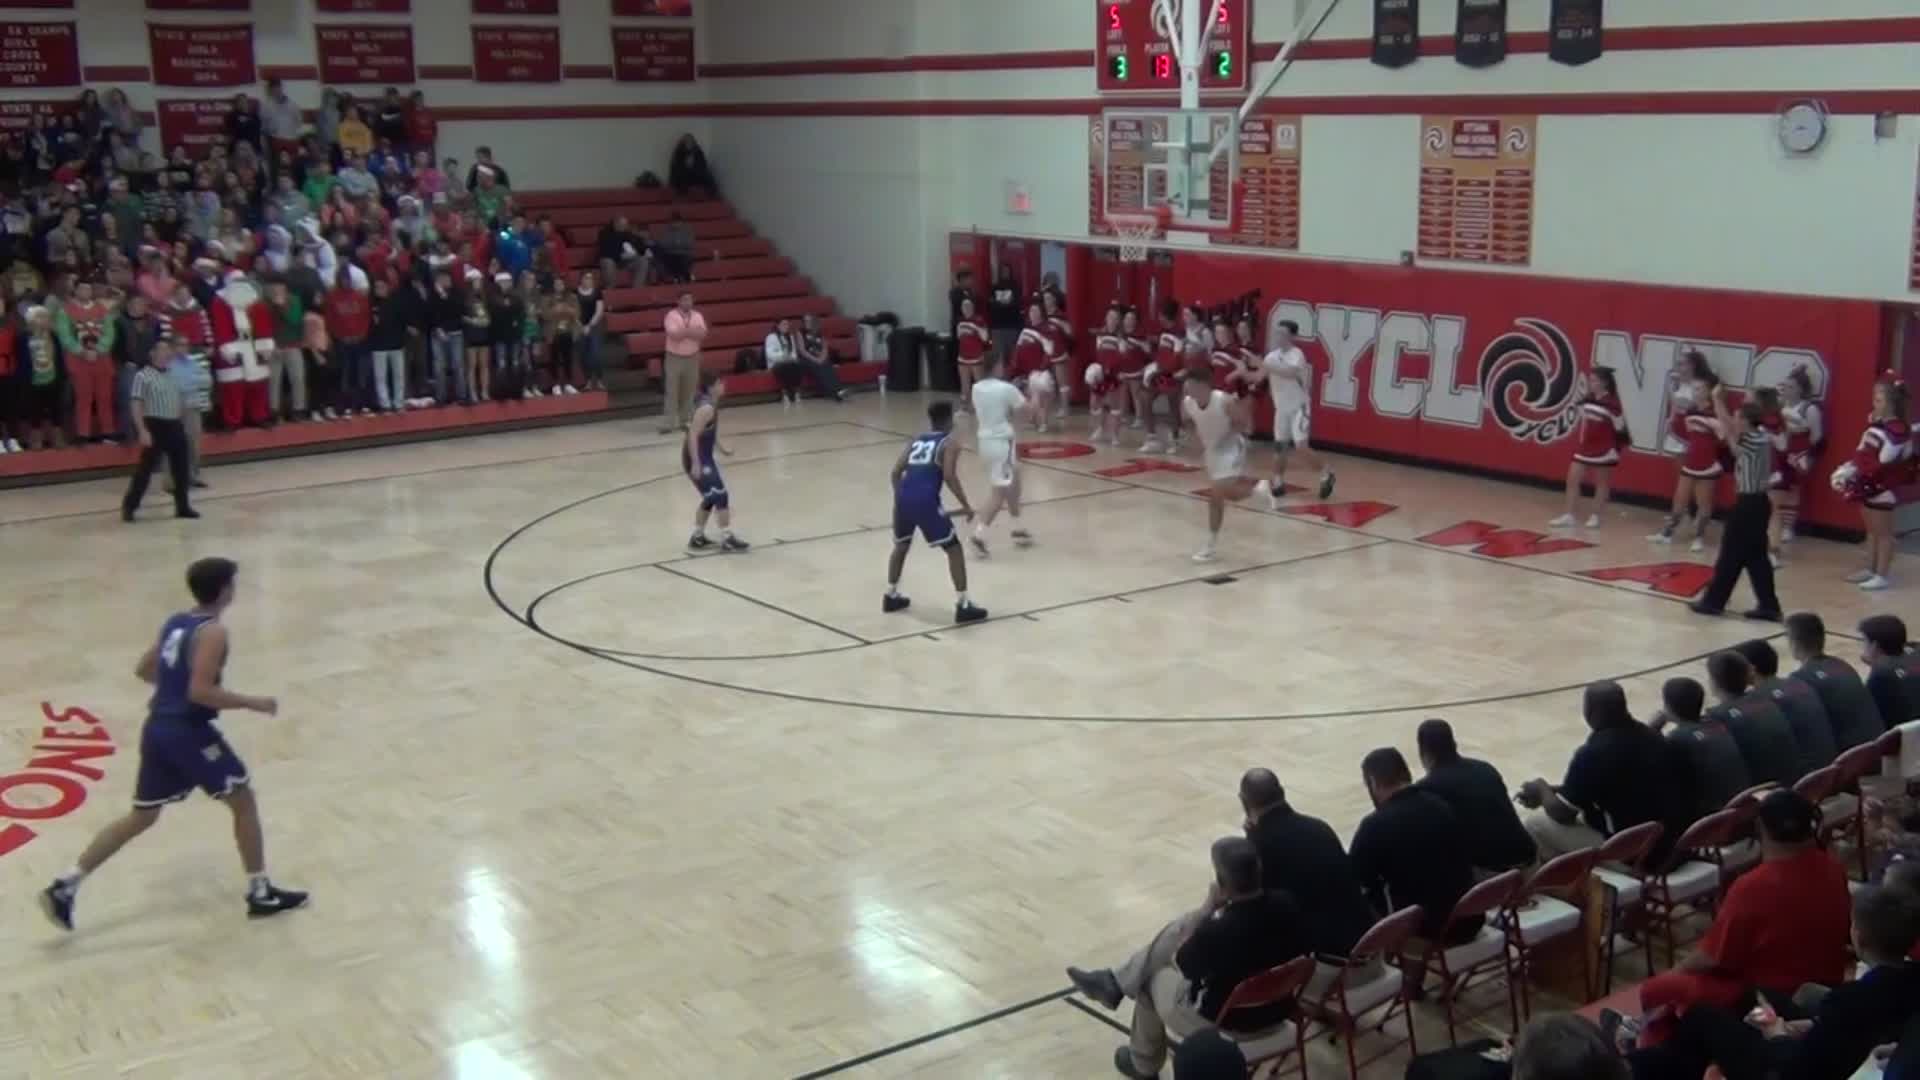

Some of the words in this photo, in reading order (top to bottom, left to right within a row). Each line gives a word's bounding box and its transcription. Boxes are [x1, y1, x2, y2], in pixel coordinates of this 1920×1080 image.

[1110, 5, 1120, 28] 5
[1116, 56, 1126, 78] 3
[1155, 55, 1170, 78] 13
[1219, 52, 1230, 75] 2
[908, 440, 935, 465] 23
[1016, 441, 1714, 599] OTAWA
